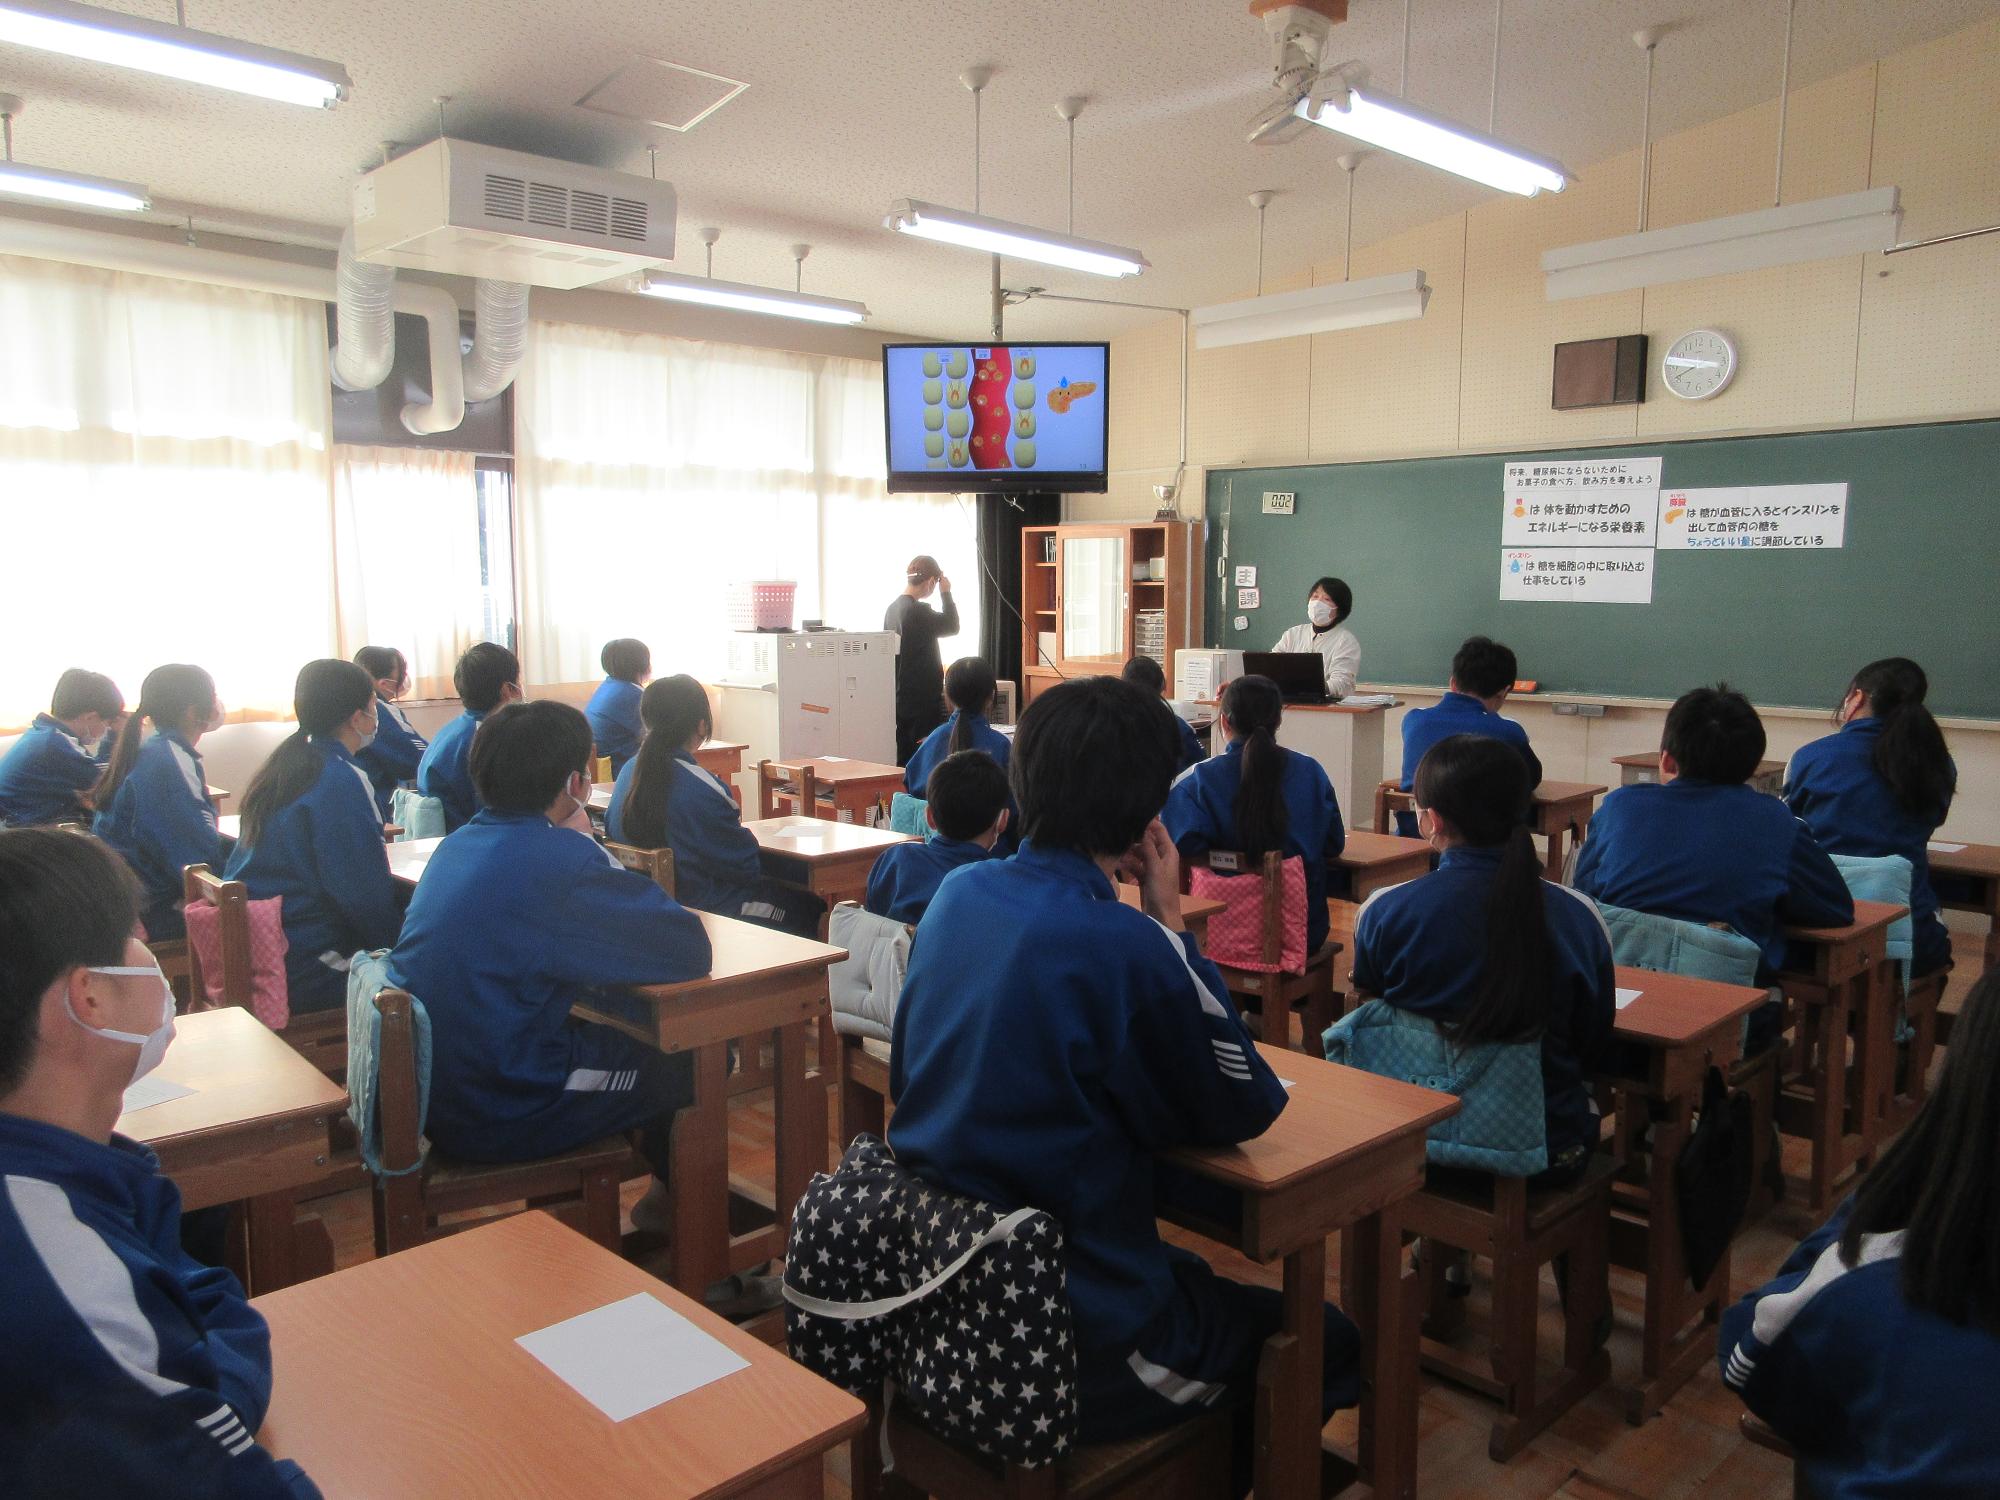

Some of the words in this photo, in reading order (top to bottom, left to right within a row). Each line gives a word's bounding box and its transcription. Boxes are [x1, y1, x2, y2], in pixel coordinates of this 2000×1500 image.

[1695, 337, 1704, 347] 12
[1695, 382, 1702, 392] 6
[1509, 465, 1627, 477] 将来、糖尿病にならないために
[1516, 475, 1653, 487] お菓子の食べ方、飲み方を考えよう
[1543, 503, 1631, 515] 体を動かすための
[1699, 504, 1840, 518] 糖が血管に入るとインスリンを
[1527, 521, 1646, 533] エネルギーになる栄養素
[1688, 521, 1780, 533] 出して血管内の糖を
[1687, 535, 1824, 547] ちょうどいい量に調節している
[1538, 560, 1645, 572] 糖を細胞の中に取り込む
[1523, 575, 1586, 586] 仕事をしている
